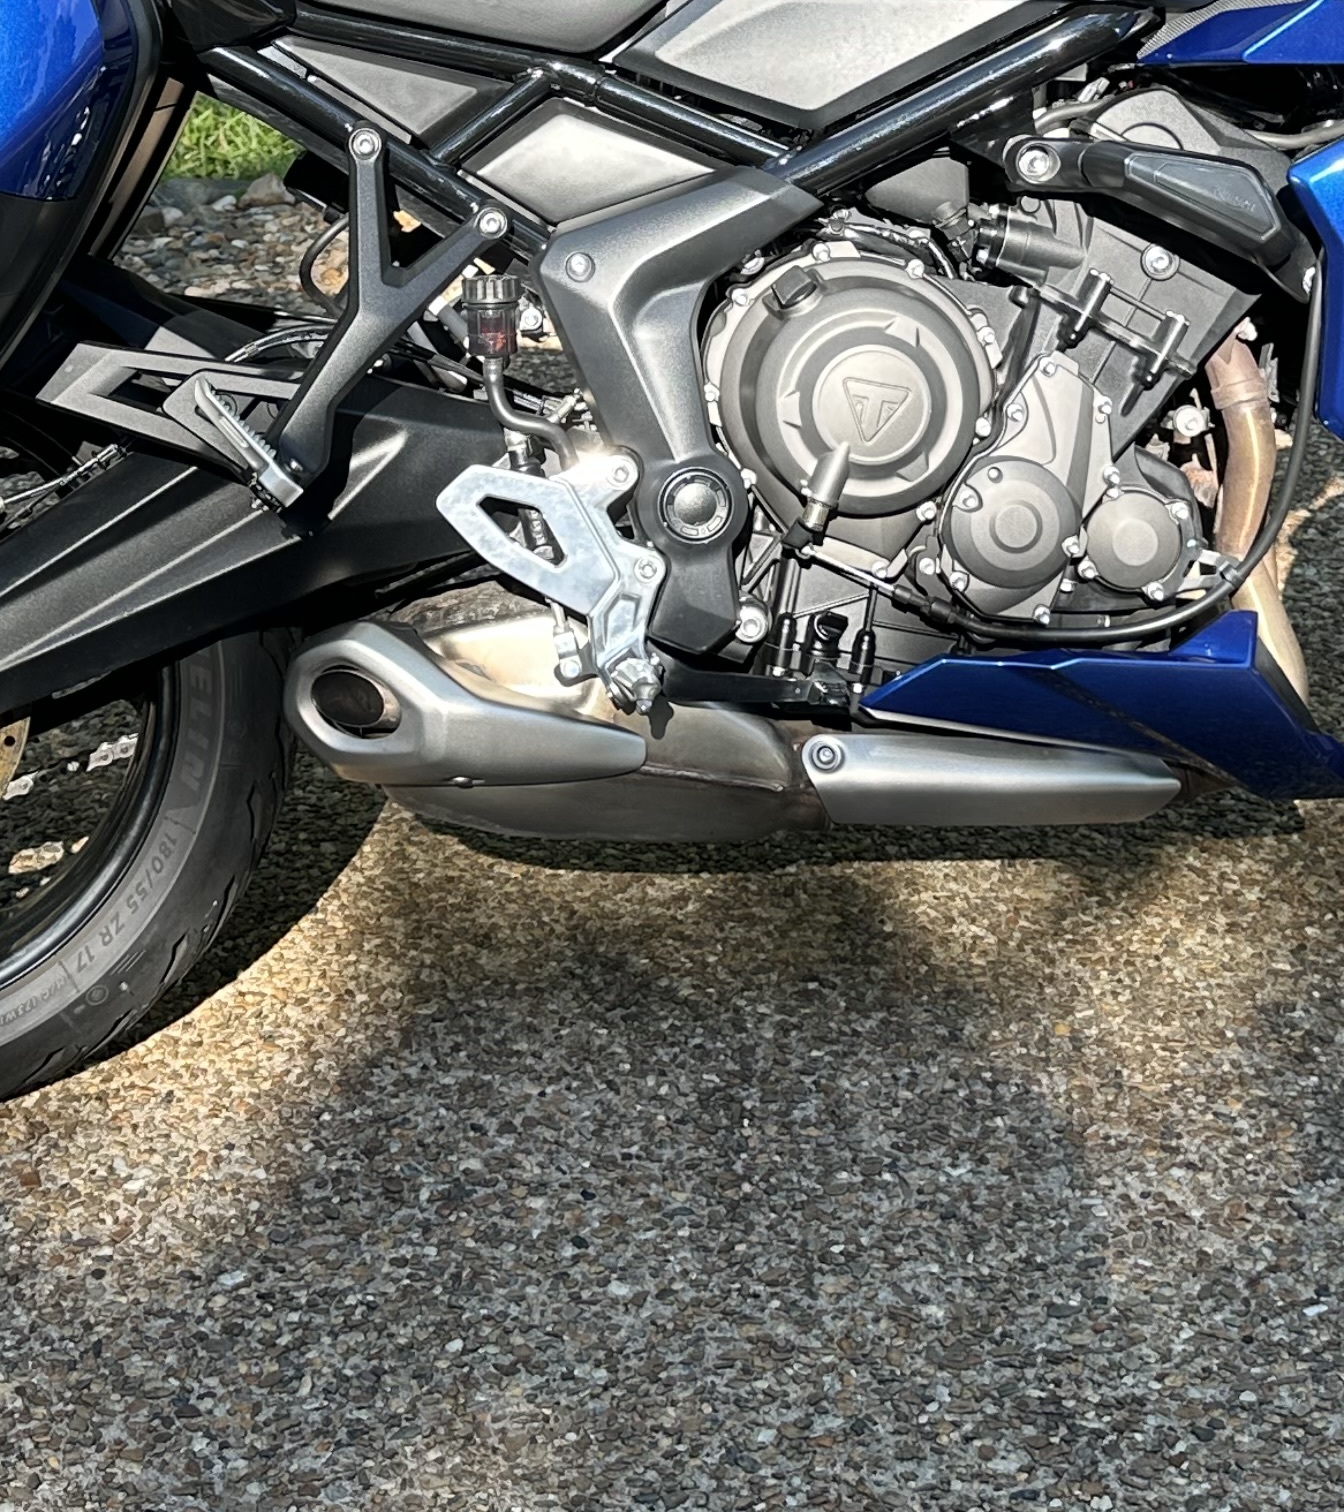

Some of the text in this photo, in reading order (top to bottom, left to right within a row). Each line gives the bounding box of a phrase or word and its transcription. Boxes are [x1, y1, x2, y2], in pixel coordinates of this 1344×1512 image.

[179, 651, 213, 791] ELIN
[76, 833, 176, 973] 180/55 ZR 17
